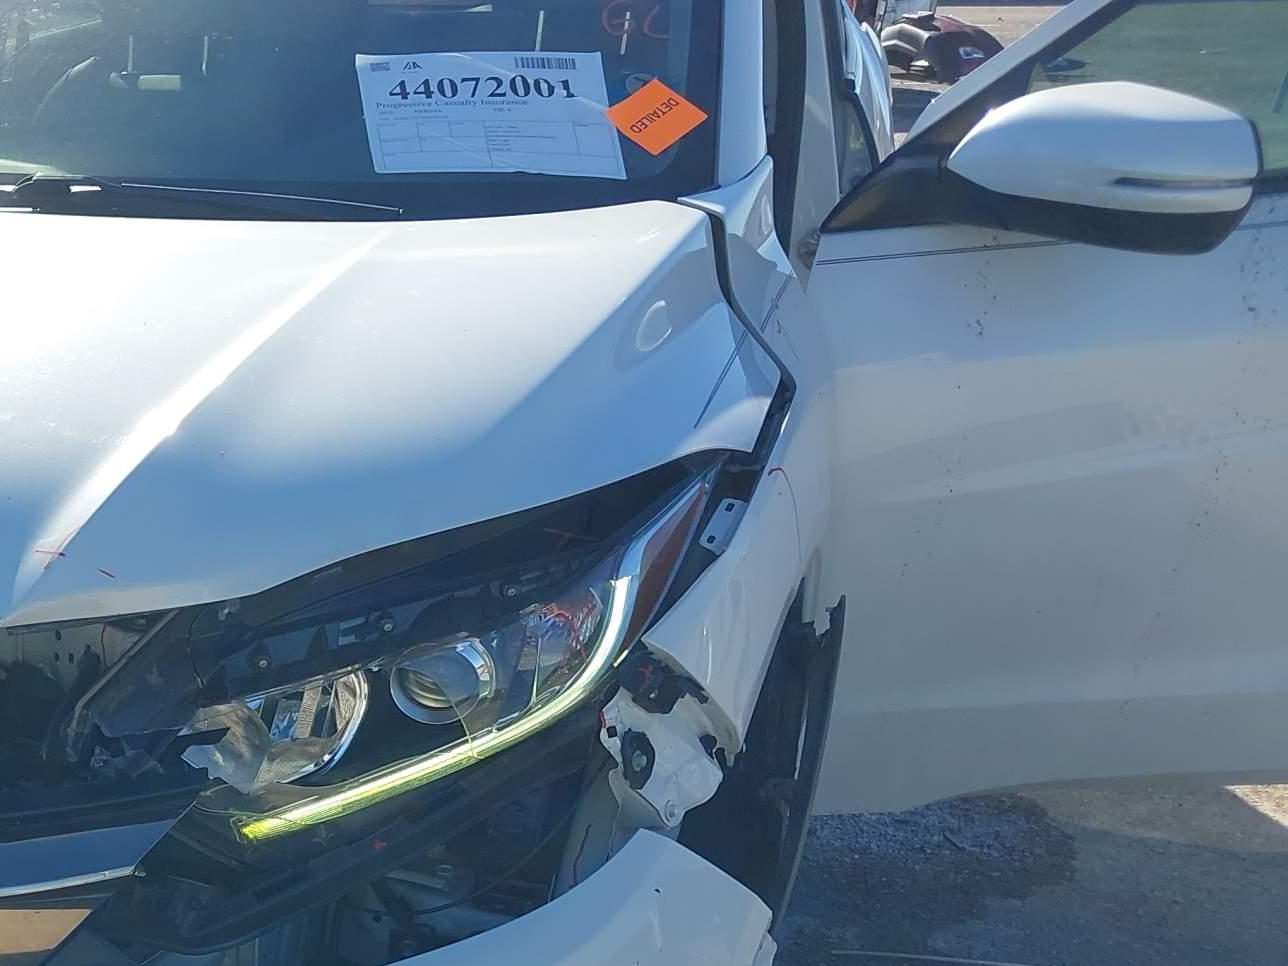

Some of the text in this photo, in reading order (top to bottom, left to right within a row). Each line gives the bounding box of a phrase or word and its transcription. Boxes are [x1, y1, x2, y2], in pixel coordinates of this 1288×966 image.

[389, 74, 578, 100] 44072001
[376, 98, 528, 109] Progressive Casualty Insurance
[630, 97, 680, 134] DETAILED
